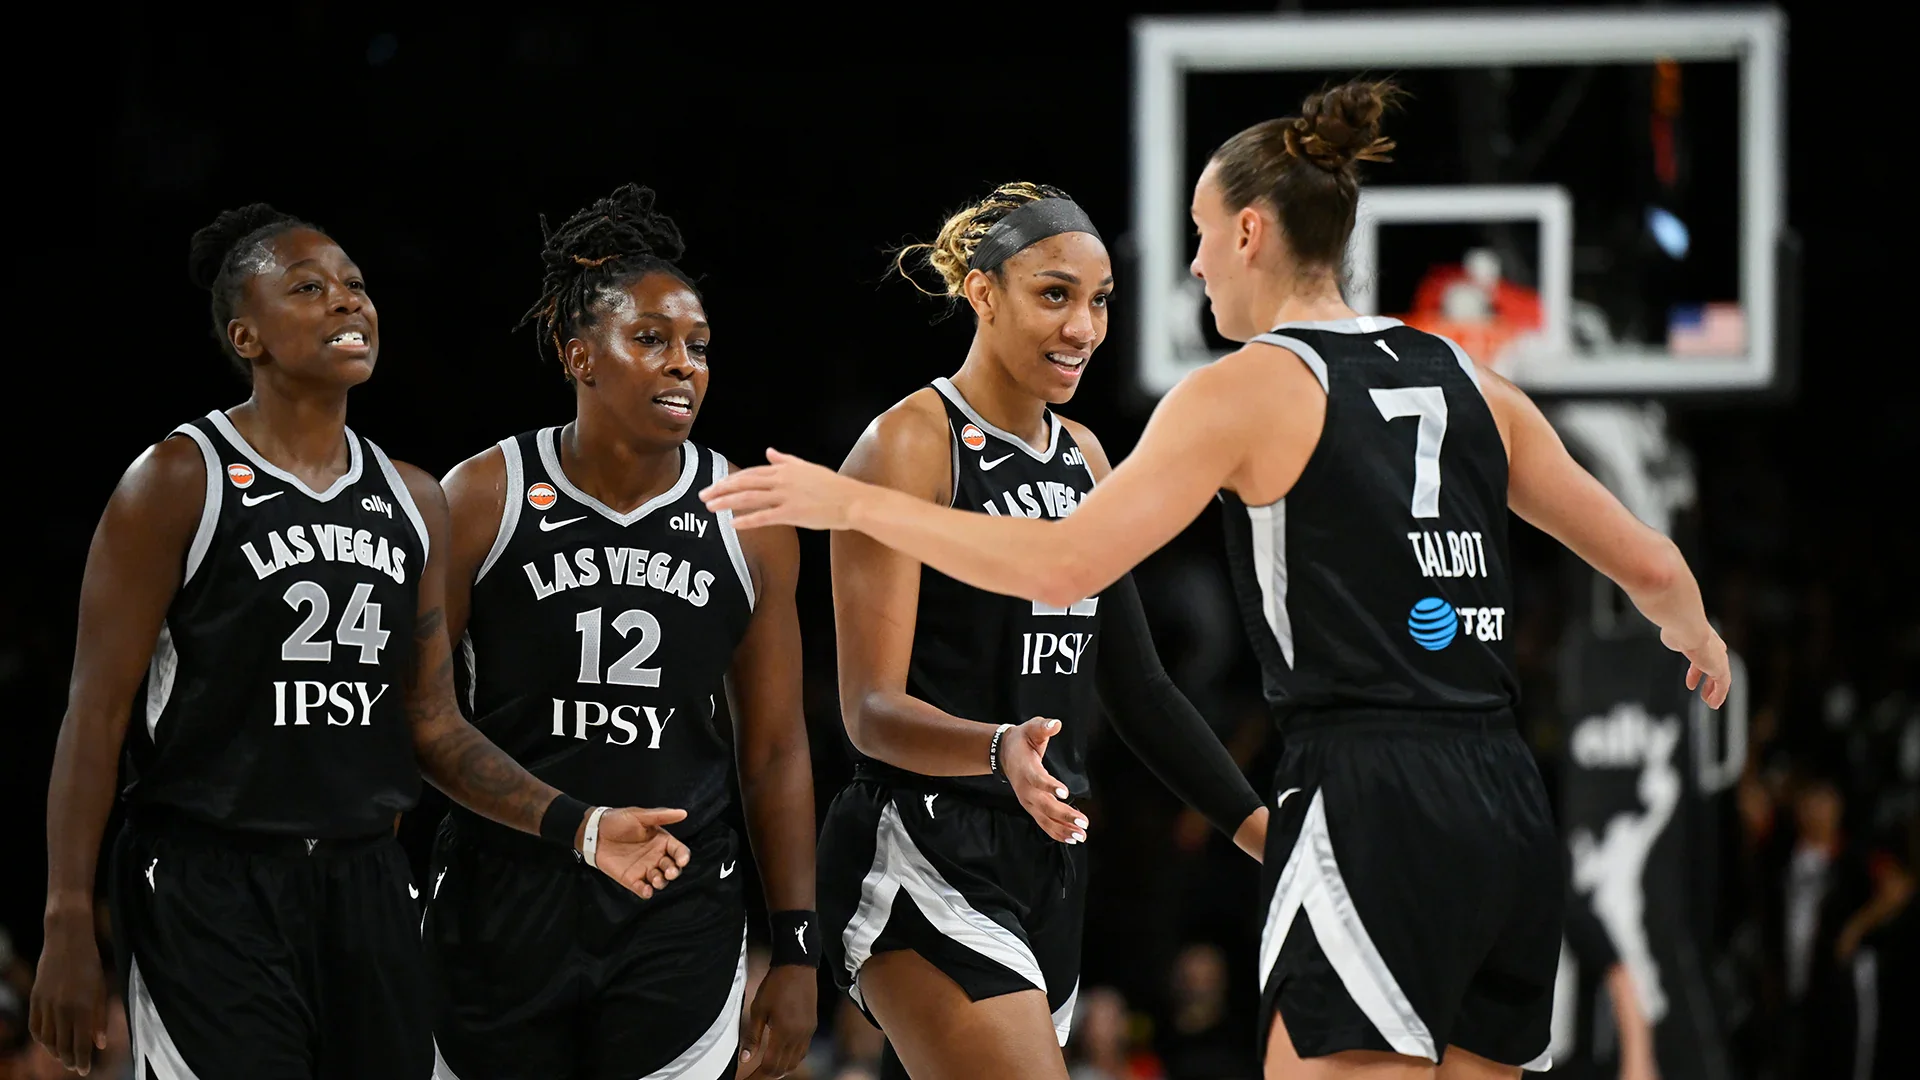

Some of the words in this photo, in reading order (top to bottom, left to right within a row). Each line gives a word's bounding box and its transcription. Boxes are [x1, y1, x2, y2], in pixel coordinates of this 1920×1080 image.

[1062, 446, 1083, 466] all
[1368, 386, 1448, 518] 7
[361, 495, 392, 519] ally
[670, 512, 708, 538] ally
[241, 524, 316, 580] LAS
[311, 524, 406, 584] VEGAS
[523, 548, 600, 600] LAS
[604, 547, 715, 607] VEGAS
[1407, 531, 1487, 578] TALBOT
[282, 581, 391, 664] 24
[1455, 607, 1505, 641] T&T
[576, 607, 661, 687] 12
[1021, 633, 1093, 675] IPSY
[273, 681, 389, 726] IPSY
[552, 698, 675, 749] IPSY
